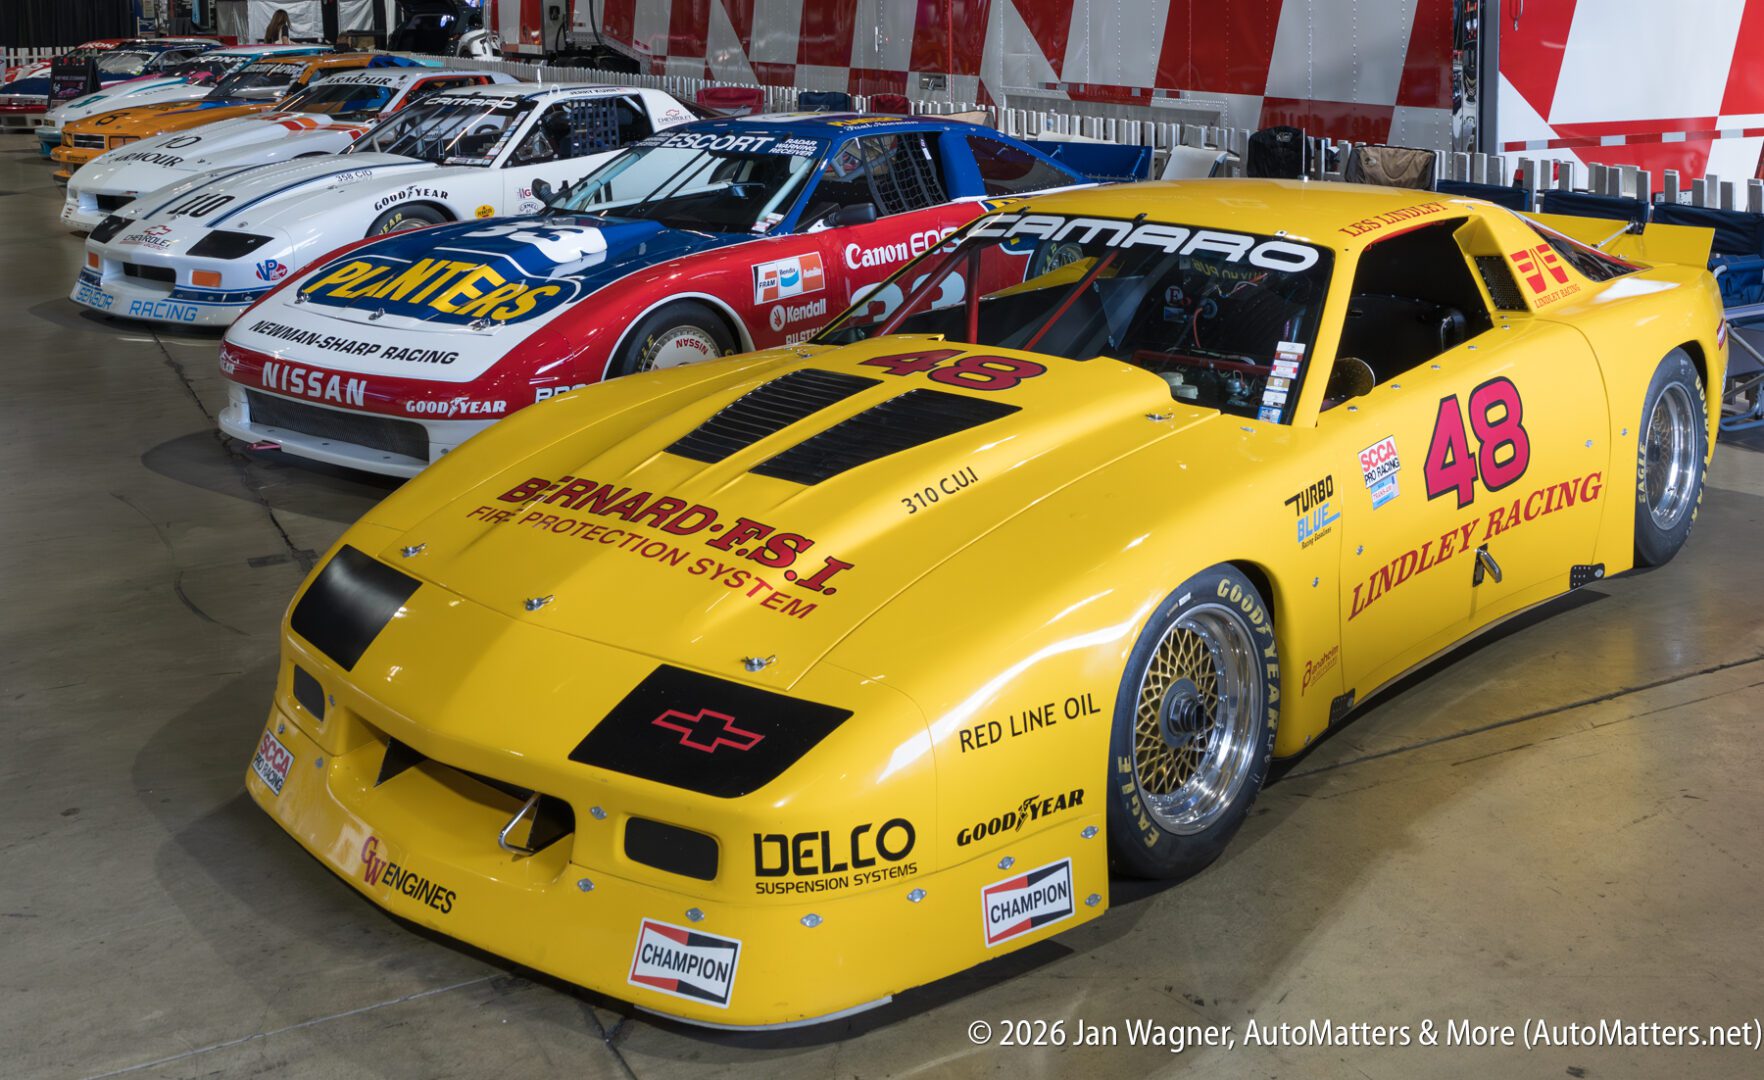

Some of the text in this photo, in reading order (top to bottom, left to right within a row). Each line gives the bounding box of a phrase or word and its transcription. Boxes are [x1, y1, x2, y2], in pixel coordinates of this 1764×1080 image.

[328, 73, 393, 86] ARMOUR
[424, 97, 518, 110] CAMARO
[110, 152, 184, 167] ARMOUR
[156, 136, 202, 149] 10
[661, 133, 776, 152] ESCORT
[768, 148, 813, 157] RECEIVER
[775, 143, 817, 151] WARNING
[335, 169, 372, 183] 358 CID
[167, 193, 236, 218] 110
[374, 184, 449, 212] GOODYEAR
[1338, 200, 1449, 238] LES LINDLEY
[123, 233, 172, 248] CHEVROLET
[845, 227, 961, 270] Canon EOS
[966, 212, 1320, 272] CAMARO
[256, 259, 278, 281] VP
[759, 278, 777, 289] FRAM
[780, 267, 797, 276] Bendix
[76, 287, 198, 321] SENSOR RACING
[304, 259, 560, 320] PLANTERS
[1533, 284, 1582, 308] LINDLEY RACING
[787, 299, 826, 324] Kendall
[249, 320, 460, 365] NEWMAN-SHARP RACING
[676, 337, 708, 355] NISSAN
[262, 361, 367, 407] NISSAN
[860, 348, 1047, 391] 48
[406, 397, 507, 417] GOODYEAR
[1361, 440, 1397, 472] SCCA
[1423, 375, 1531, 510] 48
[1364, 457, 1400, 485] PRO RACING
[1637, 441, 1646, 503] EAGLE
[901, 487, 939, 514] 310
[1284, 474, 1334, 517] TURBO
[1297, 502, 1341, 543] BLUE
[467, 505, 818, 619] FIRE PROTECTION SYSTEM
[1347, 471, 1603, 621] LINDLEY RACING
[1217, 578, 1281, 729] GOODYEAR
[960, 693, 1101, 753] RED LINE OIL
[254, 752, 284, 791] PRO RACING
[260, 733, 291, 779] SCCA
[957, 788, 1085, 847] GOODYEAR
[1118, 755, 1160, 848] EAGLE
[754, 818, 916, 878] DELCO
[382, 862, 456, 914] ENGINES
[755, 862, 918, 895] SUSPENSION SYSTEMS
[990, 880, 1068, 924] CHAMPION
[641, 942, 730, 983] CHAMPION
